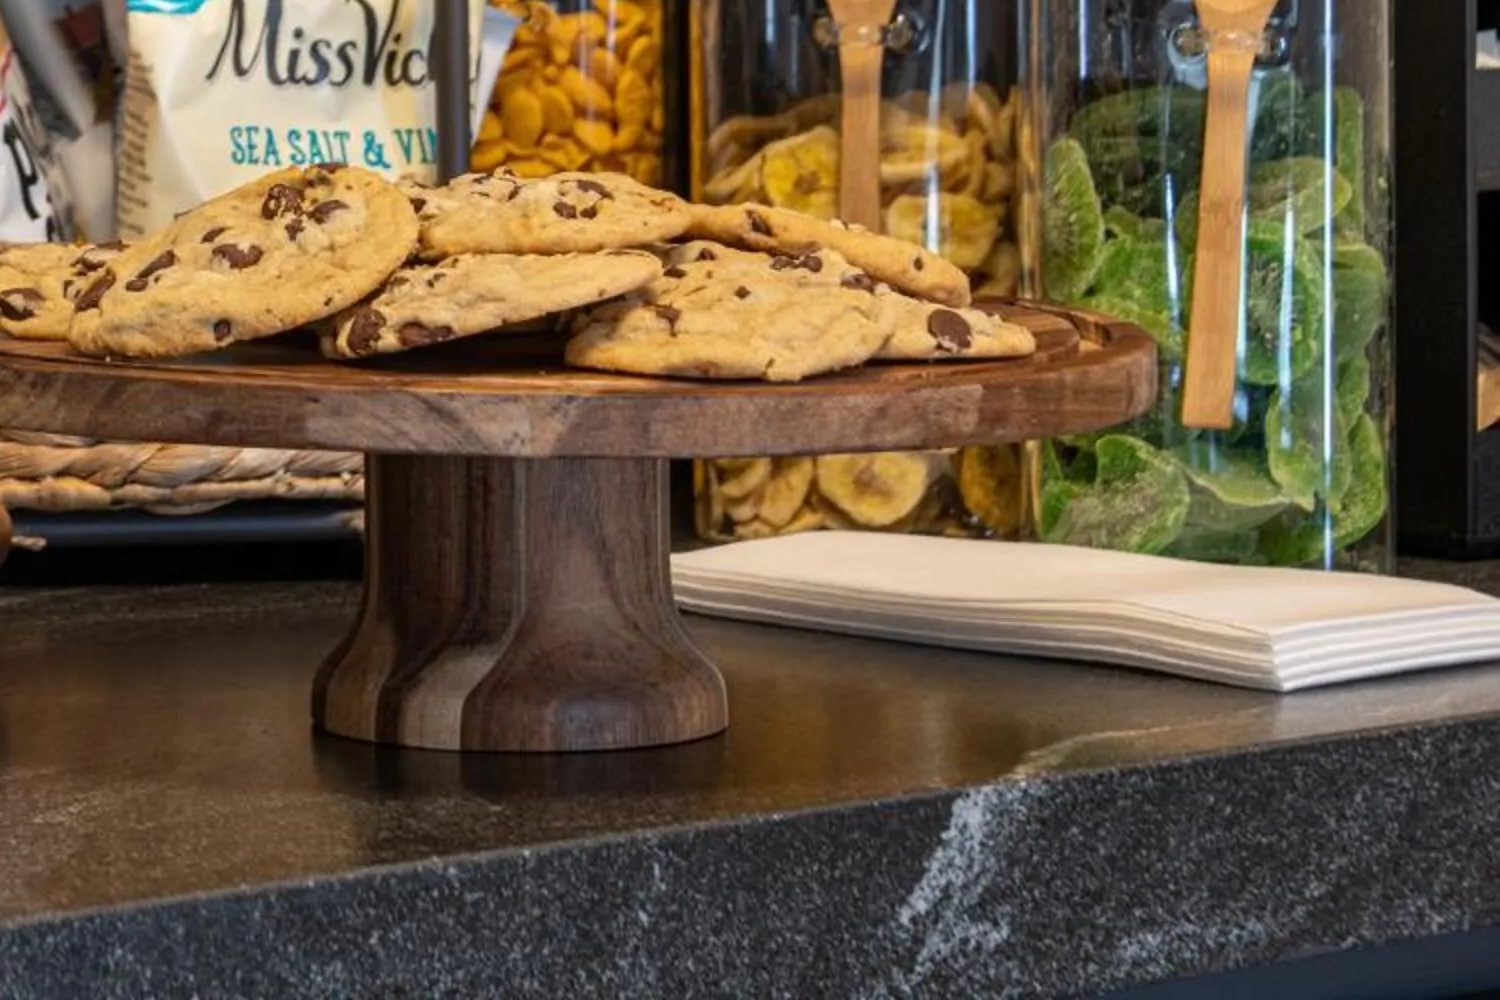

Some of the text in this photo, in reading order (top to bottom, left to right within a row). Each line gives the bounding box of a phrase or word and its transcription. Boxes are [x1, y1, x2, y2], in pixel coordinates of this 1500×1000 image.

[230, 127, 283, 167] SEA
[288, 127, 351, 167] SALT
[363, 130, 392, 169] &
